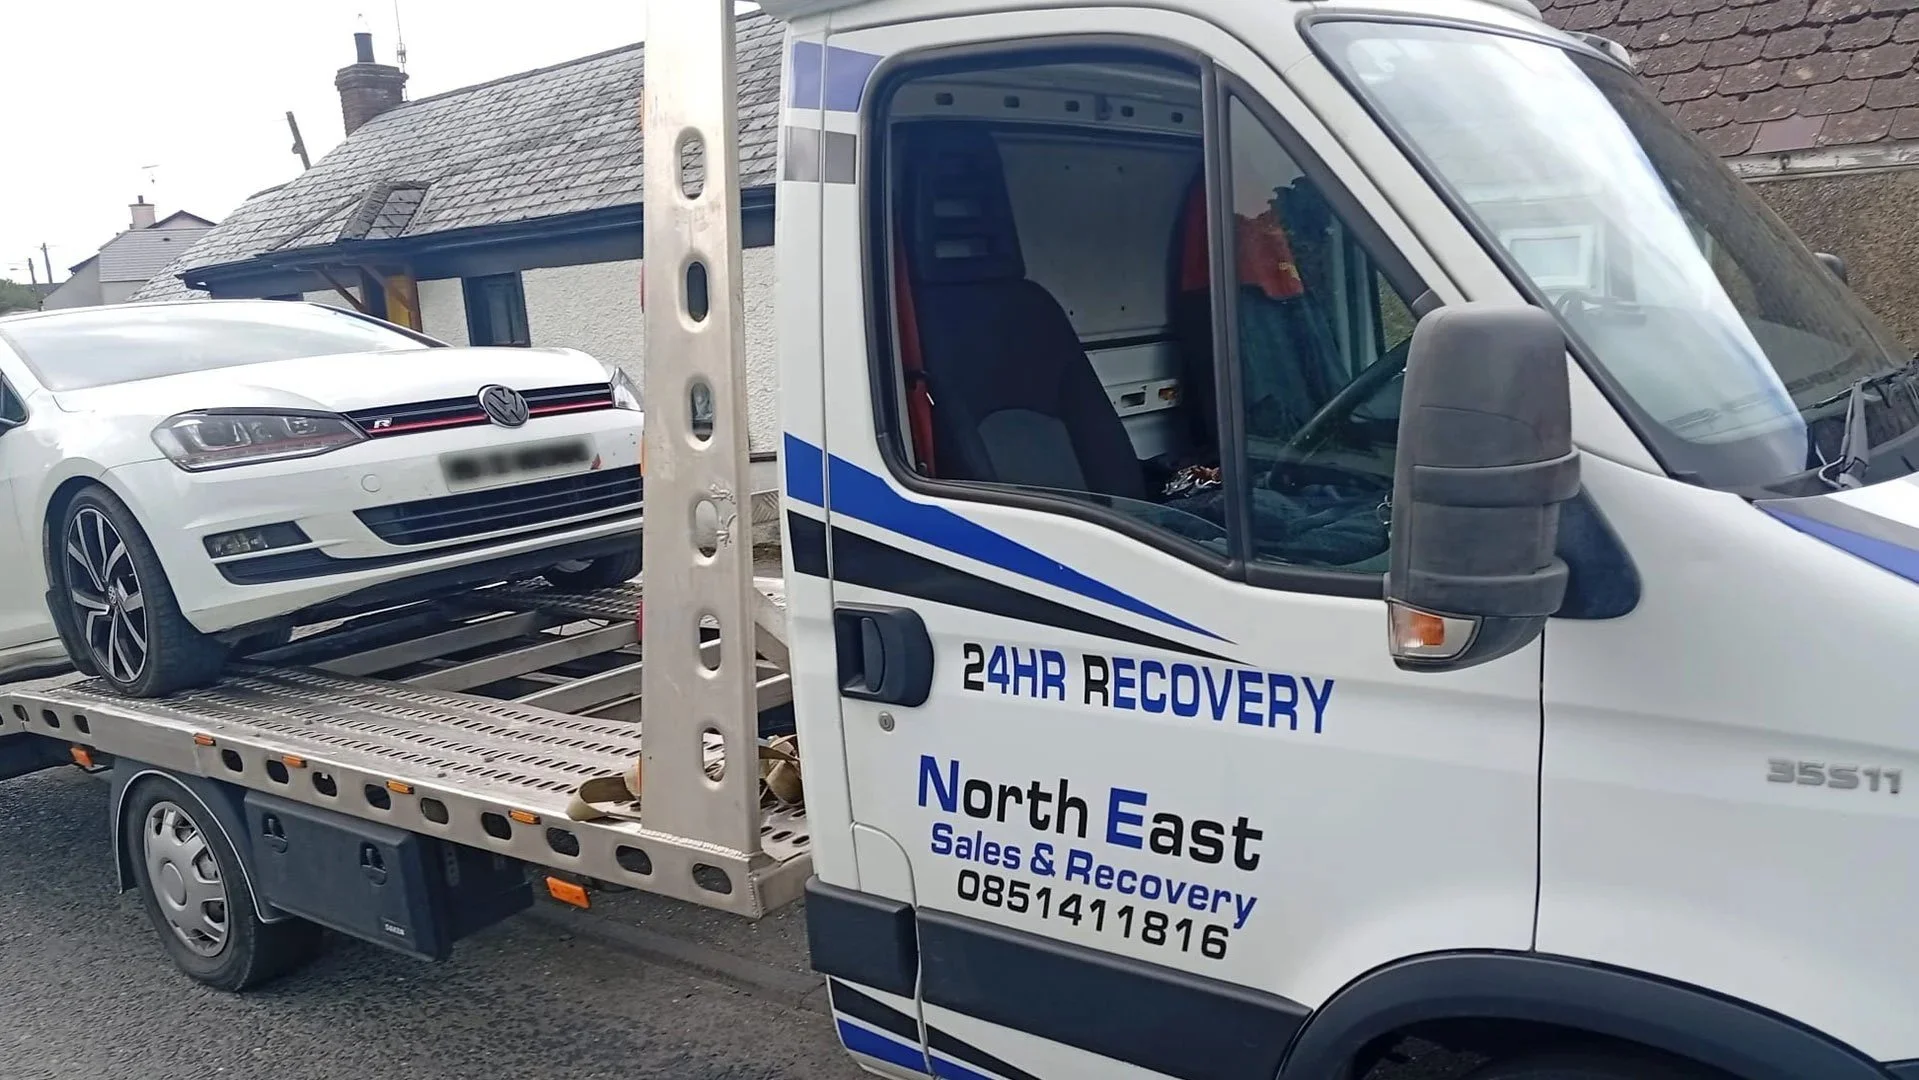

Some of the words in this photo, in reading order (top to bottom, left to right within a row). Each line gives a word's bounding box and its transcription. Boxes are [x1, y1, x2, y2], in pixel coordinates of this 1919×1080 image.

[373, 418, 393, 429] R
[963, 643, 1066, 701] 24HR
[1082, 654, 1335, 734] RECOVERY
[918, 754, 1088, 839] North
[1106, 787, 1263, 871] East
[931, 823, 1021, 870] Sales
[1030, 842, 1055, 878] &
[1066, 849, 1257, 929] Recovery
[957, 869, 1229, 960] 0851411816
